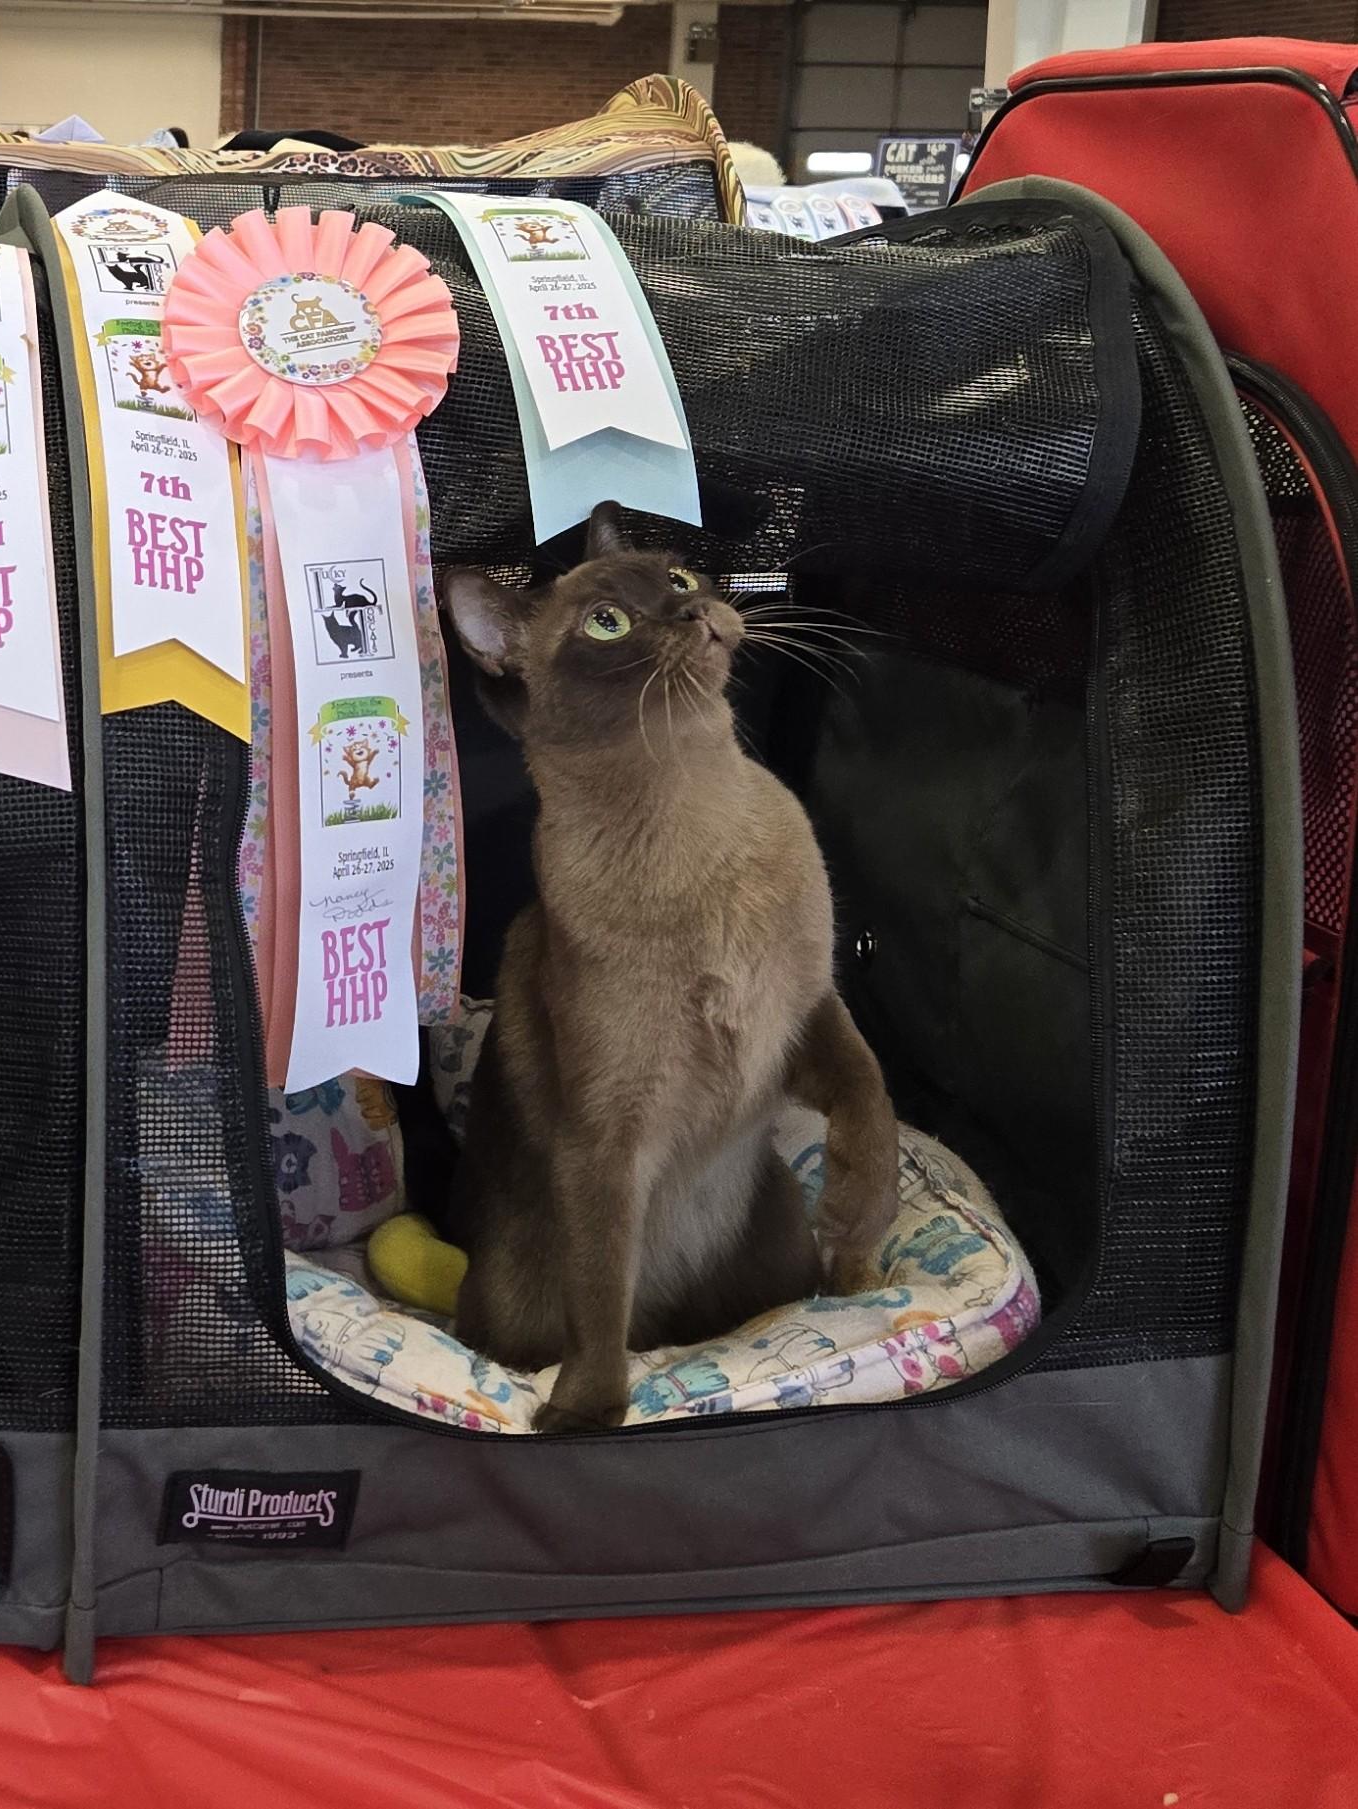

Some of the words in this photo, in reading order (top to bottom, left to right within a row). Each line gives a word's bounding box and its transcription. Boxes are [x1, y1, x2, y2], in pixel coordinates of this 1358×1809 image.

[886, 143, 917, 162] CAT
[529, 284, 548, 292] April
[577, 282, 597, 290] 2025
[290, 307, 340, 332] CFA
[544, 303, 599, 321] 7th
[282, 336, 299, 344] THE
[300, 333, 315, 341] CAT
[536, 332, 622, 363] BEST
[549, 360, 626, 392] HHP
[131, 440, 149, 452] April
[151, 444, 177, 459] 26-27,
[178, 450, 197, 462] 2025
[135, 430, 181, 449] Springfield,
[181, 438, 191, 449] IL
[140, 471, 193, 501] 7th
[125, 508, 207, 558] BEST
[132, 547, 204, 594] HHP
[340, 669, 373, 680] presents
[338, 848, 381, 865] Springfield,
[382, 846, 390, 857] IL
[333, 866, 351, 880] April
[352, 862, 375, 876] 26-27,
[377, 859, 394, 872] 2025
[321, 917, 391, 982] BEST
[325, 970, 388, 1028] HHP
[183, 1484, 246, 1527] Sturdi
[247, 1489, 337, 1526] Products
